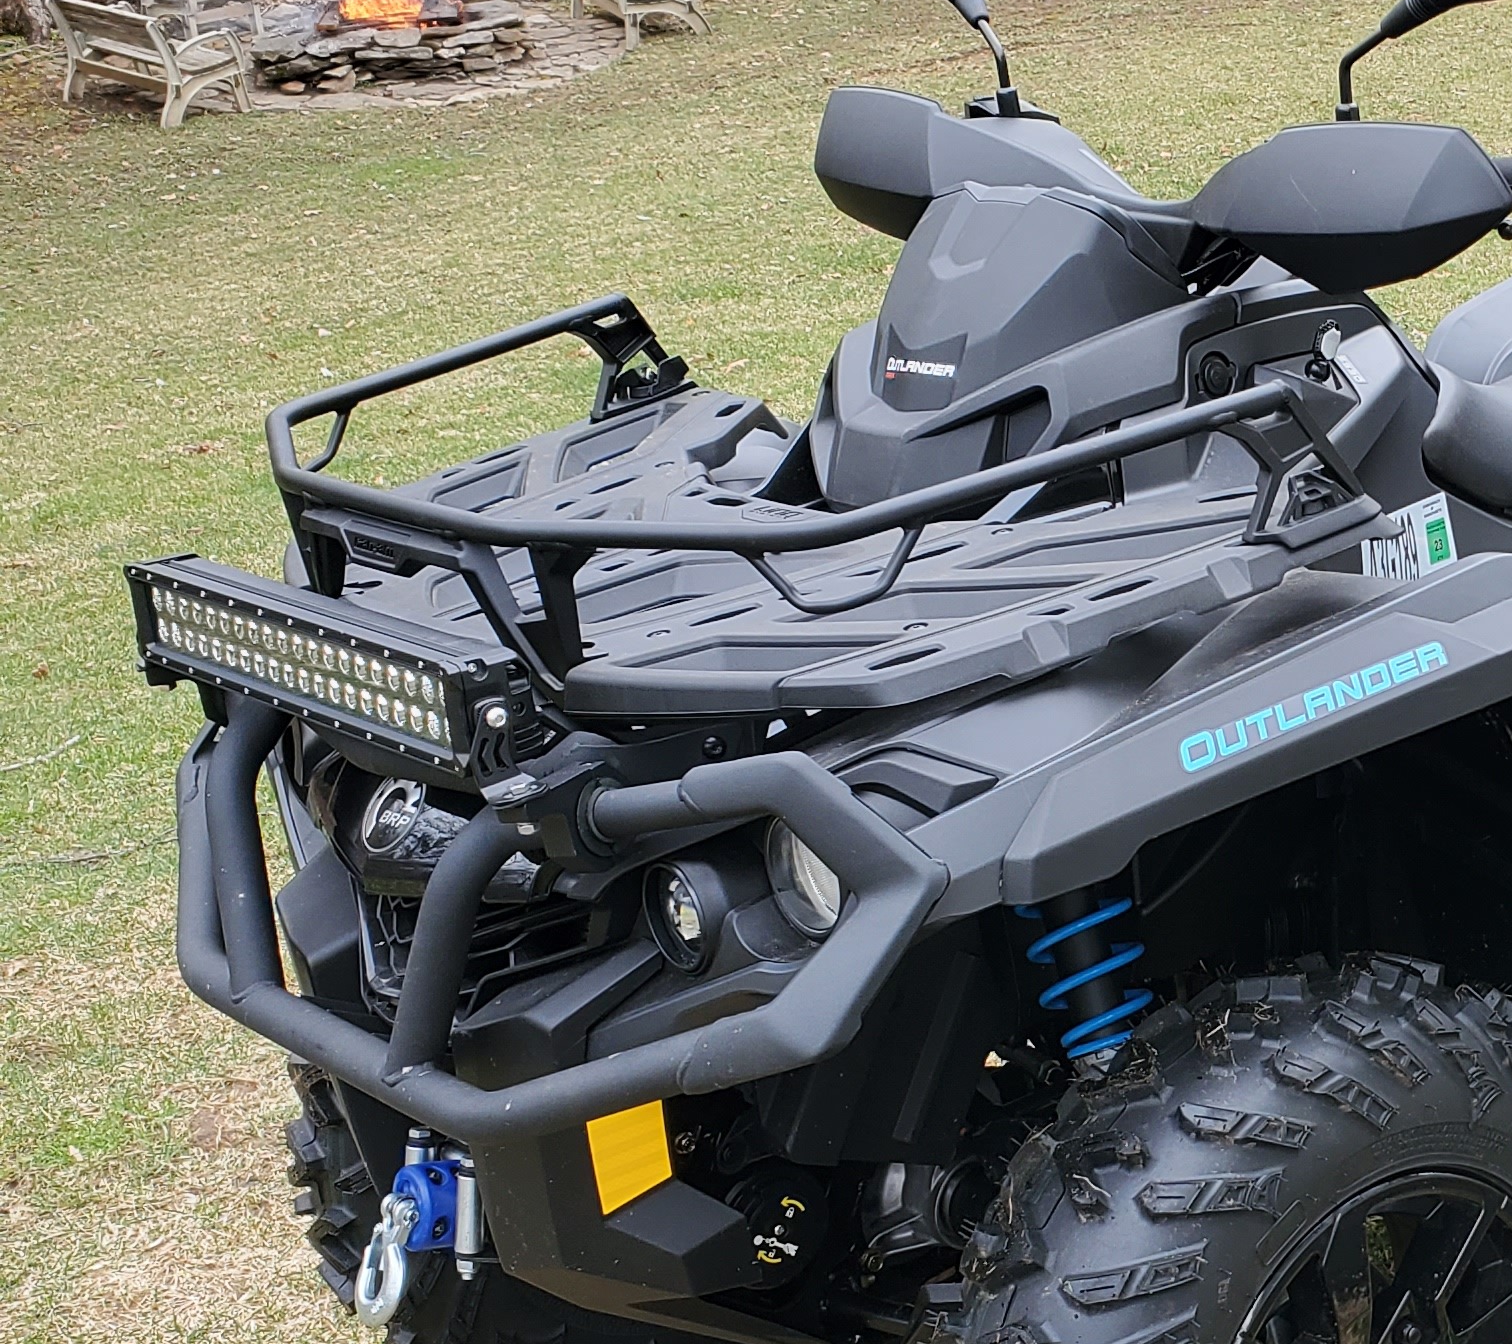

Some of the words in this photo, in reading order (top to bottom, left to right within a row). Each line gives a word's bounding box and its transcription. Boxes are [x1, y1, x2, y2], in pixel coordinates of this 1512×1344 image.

[886, 356, 955, 377] OUTLANDER
[1179, 640, 1449, 773] OUTLANDER
[379, 809, 411, 828] BRP
